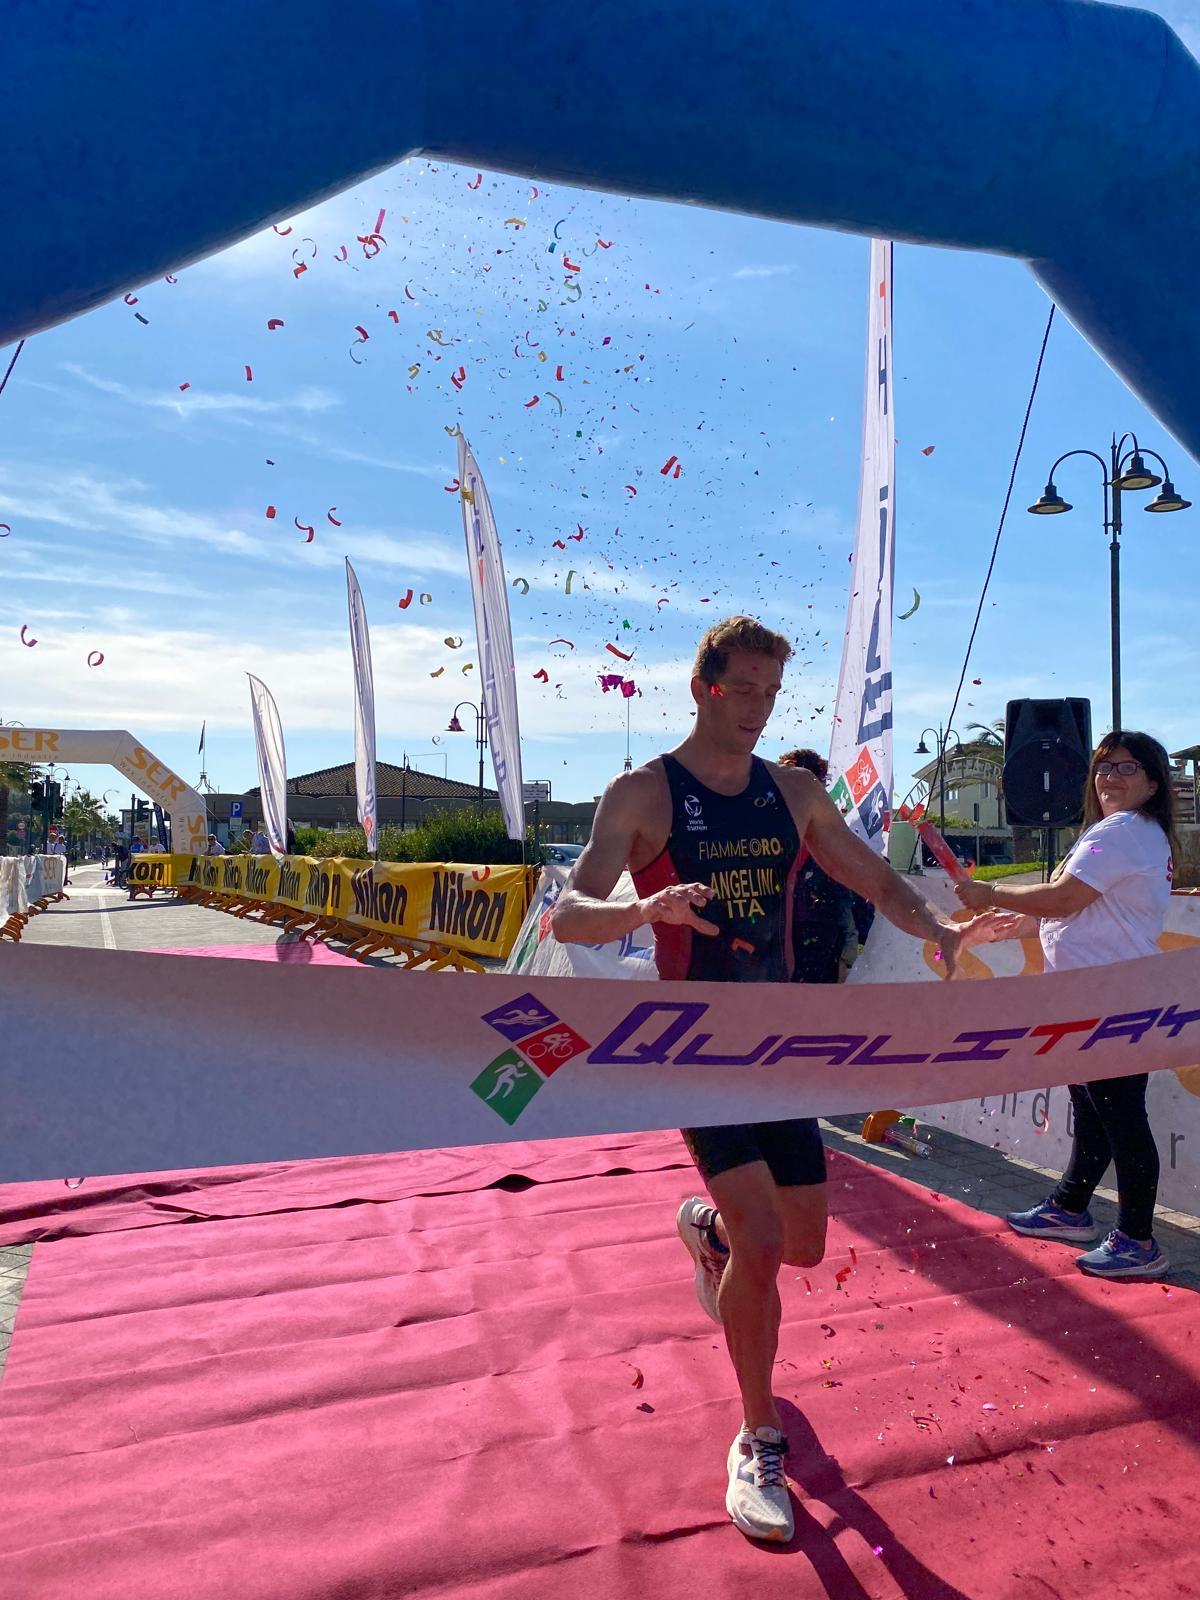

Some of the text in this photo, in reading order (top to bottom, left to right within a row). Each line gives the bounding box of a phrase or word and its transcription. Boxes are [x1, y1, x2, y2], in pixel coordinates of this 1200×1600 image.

[126, 747, 186, 800] SER
[232, 802, 241, 816] P
[350, 867, 408, 926] Nikon
[710, 868, 774, 899] ANGELINI
[429, 871, 507, 942] Nikon
[727, 899, 766, 919] ITA
